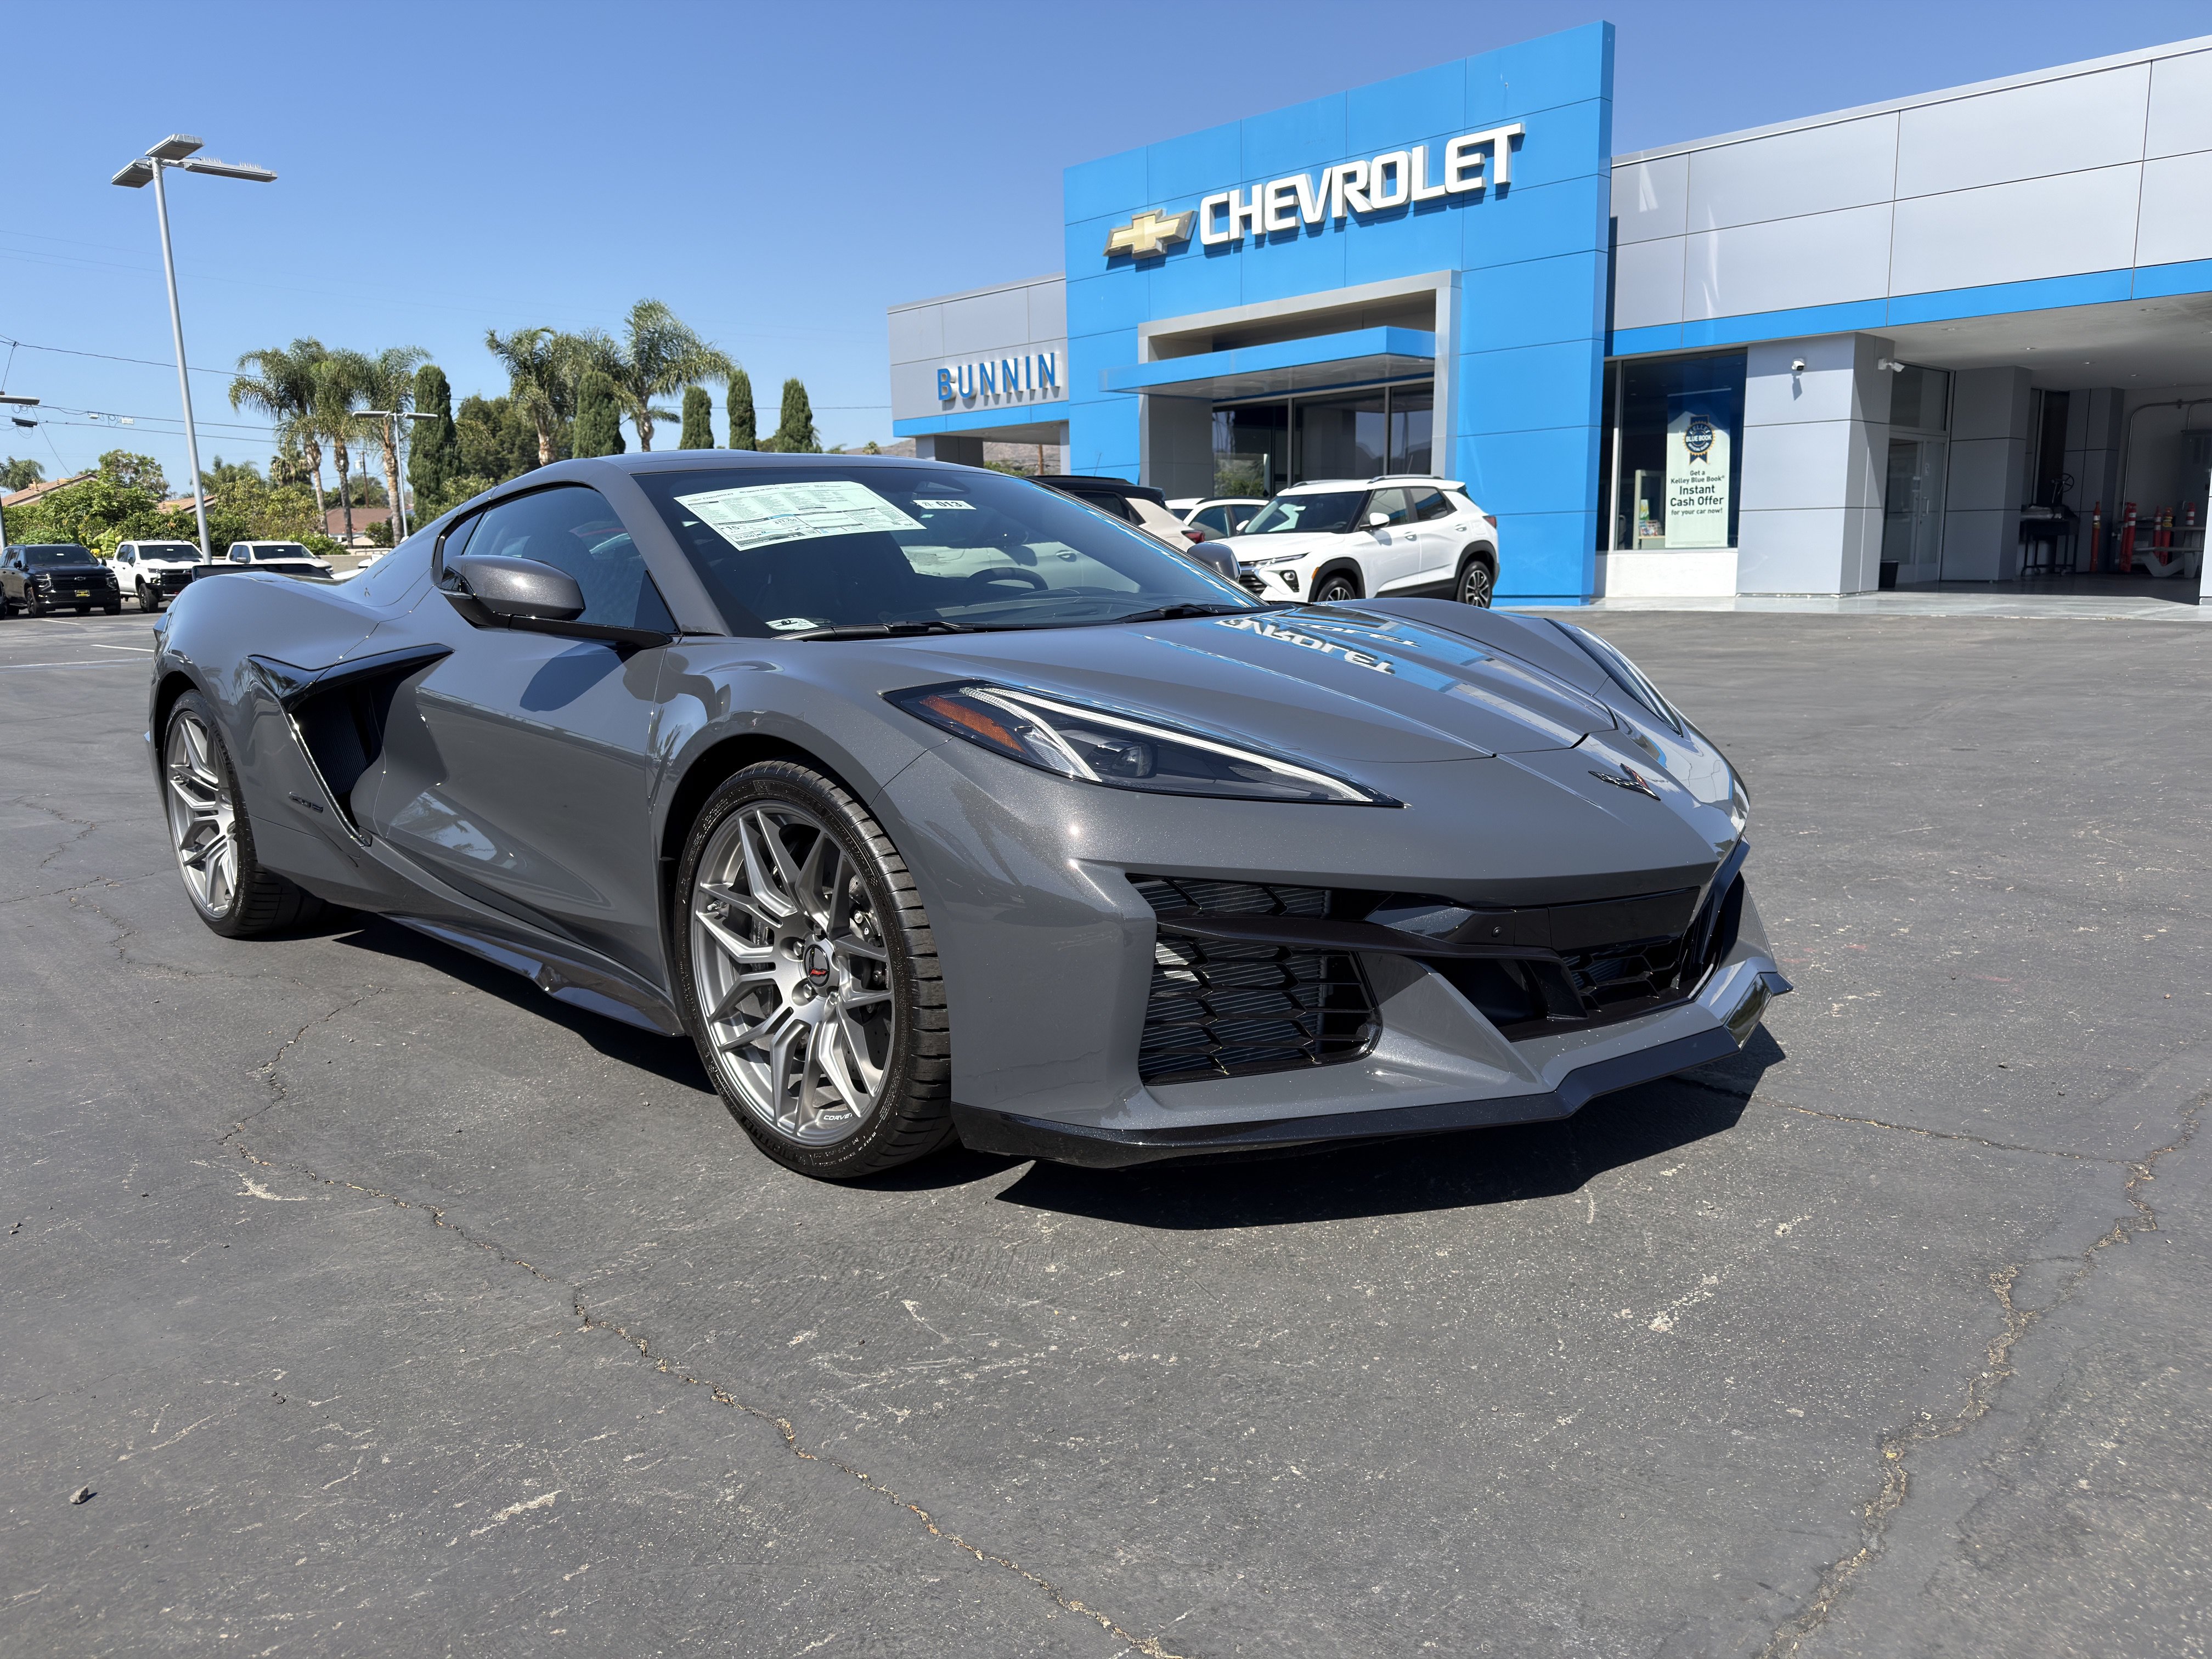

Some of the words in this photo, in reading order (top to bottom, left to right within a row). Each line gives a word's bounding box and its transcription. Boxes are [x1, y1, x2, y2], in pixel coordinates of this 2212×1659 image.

[1200, 122, 1526, 245] CHEVROLET
[937, 352, 1061, 401] BUNNIN
[1671, 497, 1694, 506] Cash
[1697, 495, 1724, 505] Offer
[1679, 484, 1715, 495] Instant
